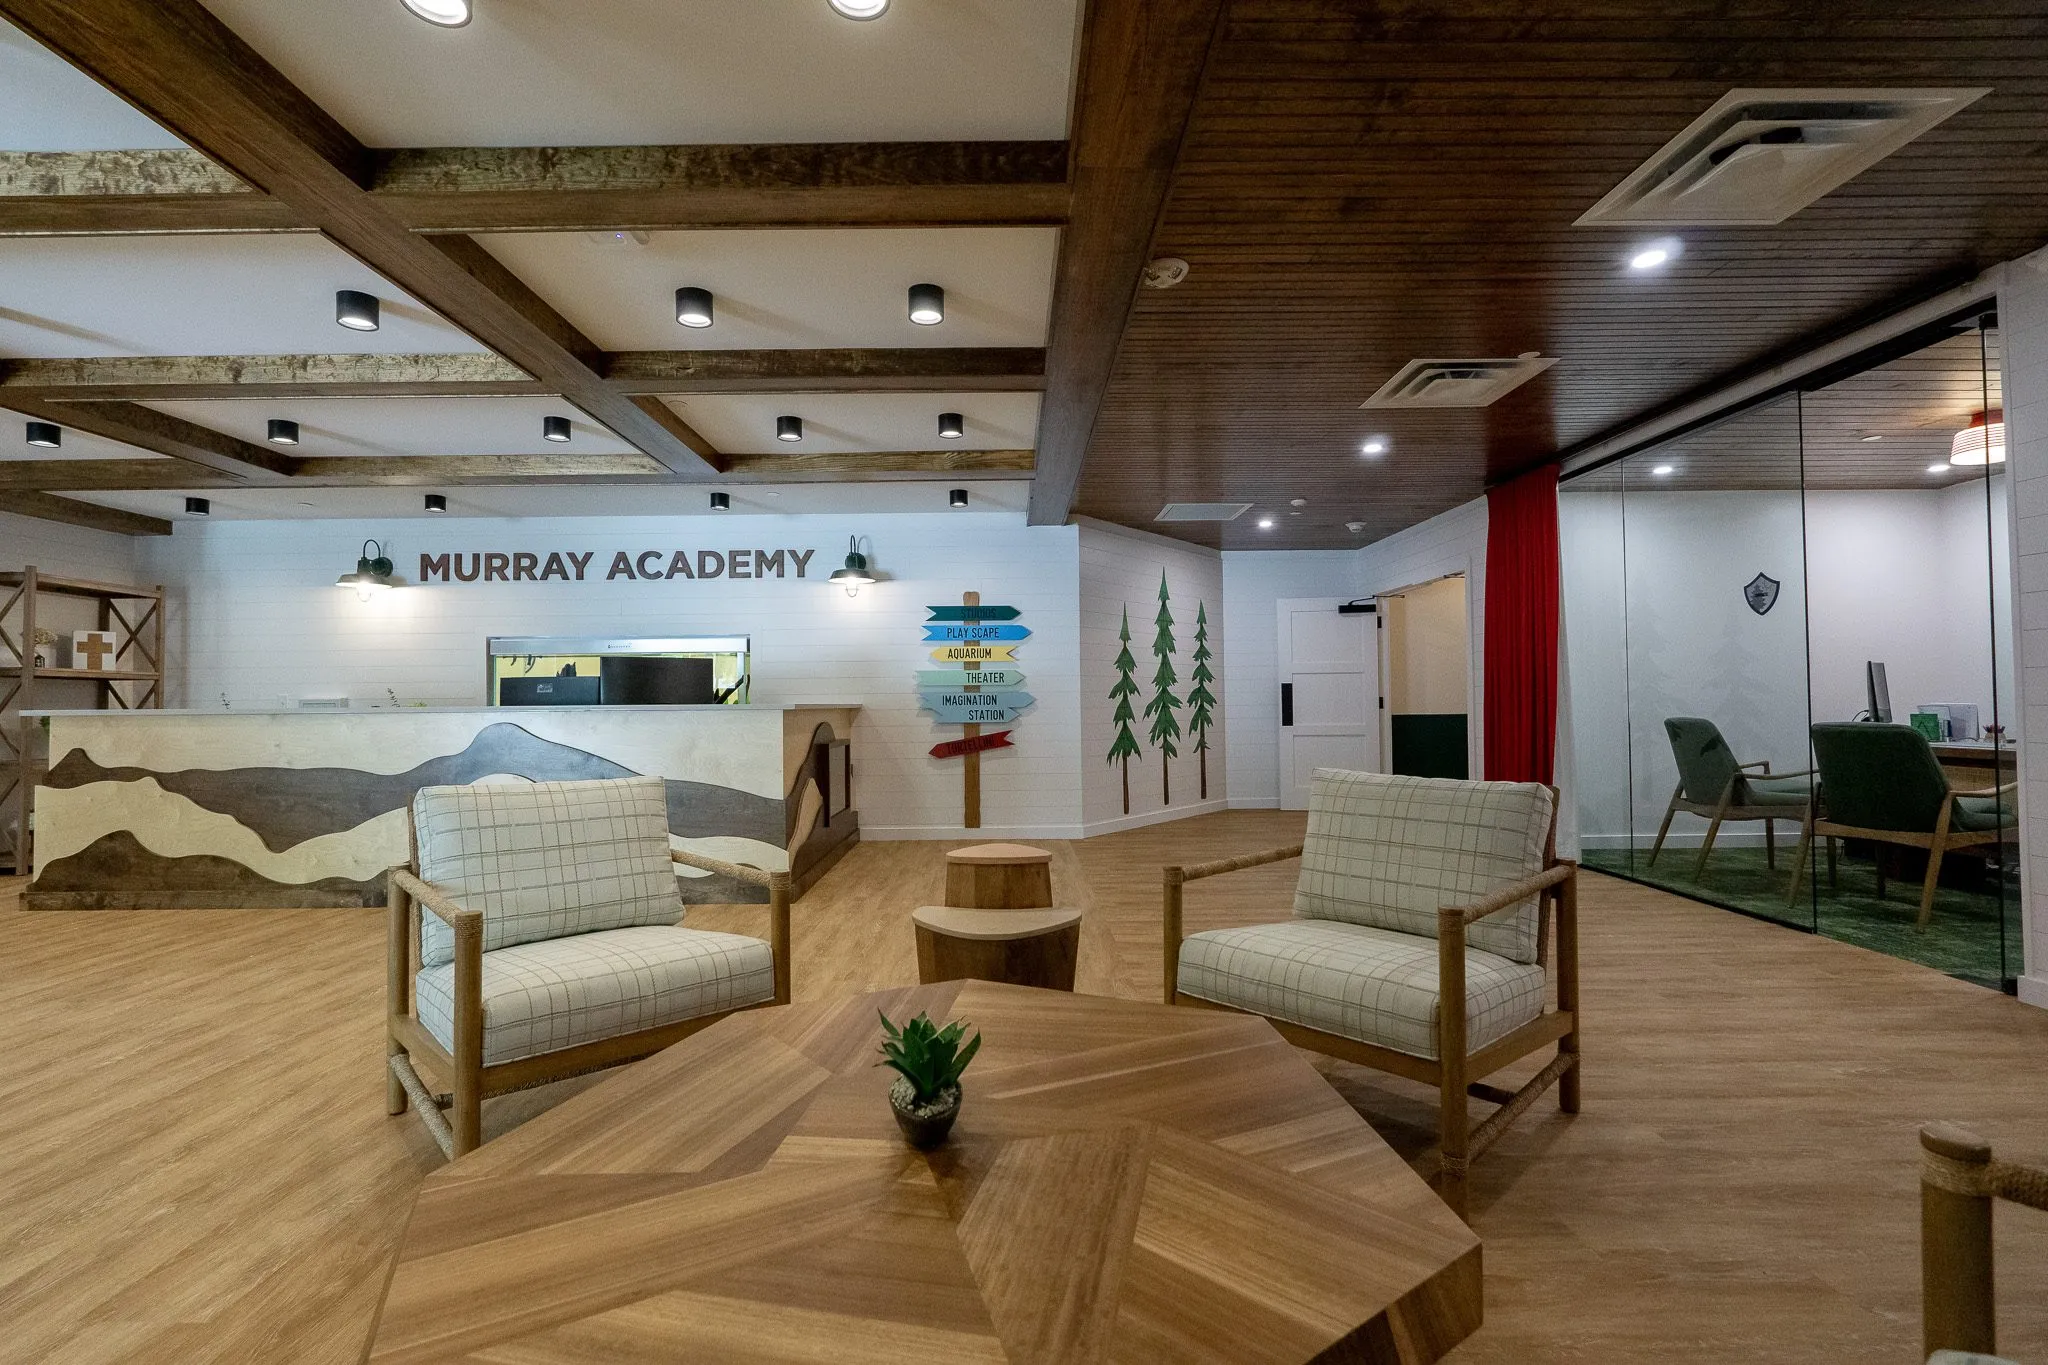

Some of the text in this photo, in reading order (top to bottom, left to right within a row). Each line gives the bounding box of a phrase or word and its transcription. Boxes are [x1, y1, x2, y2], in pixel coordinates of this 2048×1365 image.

[419, 549, 815, 582] MURRAY ACADEMY
[960, 607, 997, 618] STUDIOS
[947, 627, 1000, 638] PLAY SCAPE
[947, 648, 992, 659] AQUARIUM
[966, 672, 1005, 683] THEATER
[942, 695, 997, 706] IMAGINATION
[968, 709, 1005, 721] STATION
